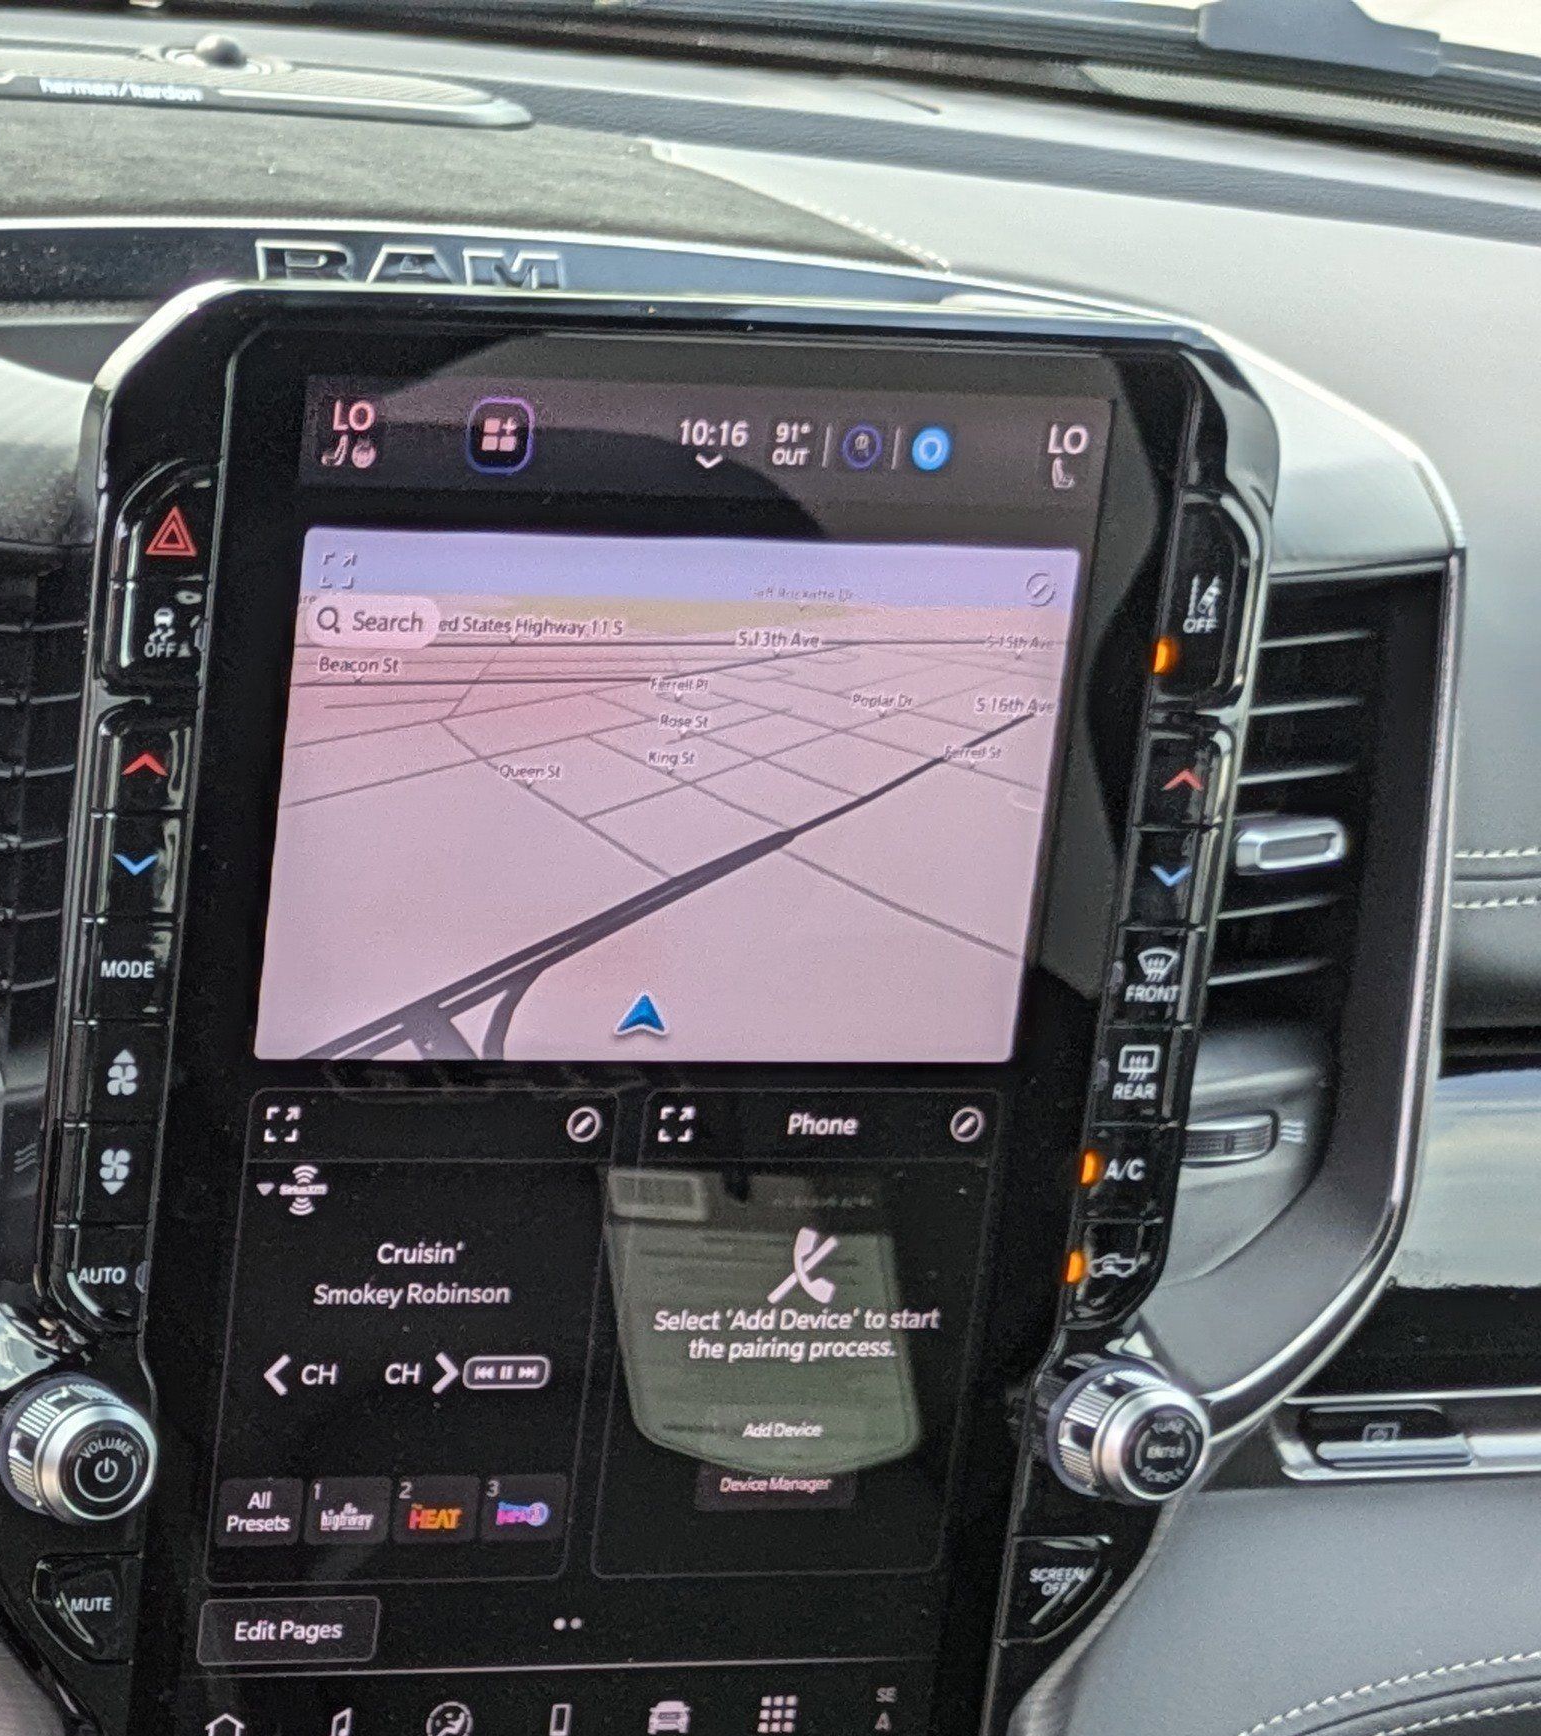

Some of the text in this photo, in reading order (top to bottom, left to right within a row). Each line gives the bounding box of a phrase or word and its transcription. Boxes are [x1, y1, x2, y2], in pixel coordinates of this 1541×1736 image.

[255, 238, 567, 290] RAM
[332, 400, 376, 431] LO
[679, 419, 749, 448] 10:16
[1047, 424, 1089, 455] LO
[771, 446, 810, 467] OUT
[352, 611, 424, 633] Search
[462, 616, 513, 634] States
[515, 618, 585, 638] Highway
[1182, 617, 1217, 635] OFF
[144, 641, 177, 658] OFF
[318, 656, 400, 674] Beacon St
[648, 751, 695, 766] King St
[499, 764, 544, 779] Queen
[100, 960, 156, 979] MODE
[1124, 984, 1180, 1003] FRONT
[1112, 1082, 1157, 1101] REAR
[787, 1112, 860, 1137] Phone
[1103, 1159, 1146, 1182] A/C
[78, 1266, 127, 1285] AUTO
[313, 1282, 512, 1310] Smokey Robinson
[653, 1309, 721, 1333] Select
[864, 1309, 886, 1330] to
[888, 1308, 942, 1330] start
[688, 1337, 899, 1363] the pairing process.
[300, 1363, 340, 1386] CH
[384, 1362, 424, 1386] CH
[742, 1422, 823, 1438] Add Device
[79, 1436, 135, 1459] VOLUME
[398, 1481, 413, 1500] 2
[486, 1479, 501, 1498] 3
[720, 1476, 832, 1495] Device Manager
[246, 1491, 272, 1510] All
[226, 1514, 291, 1534] Presets
[408, 1508, 463, 1530] HEAT
[69, 1596, 113, 1613] MUTE
[234, 1619, 344, 1646] Edit Pages
